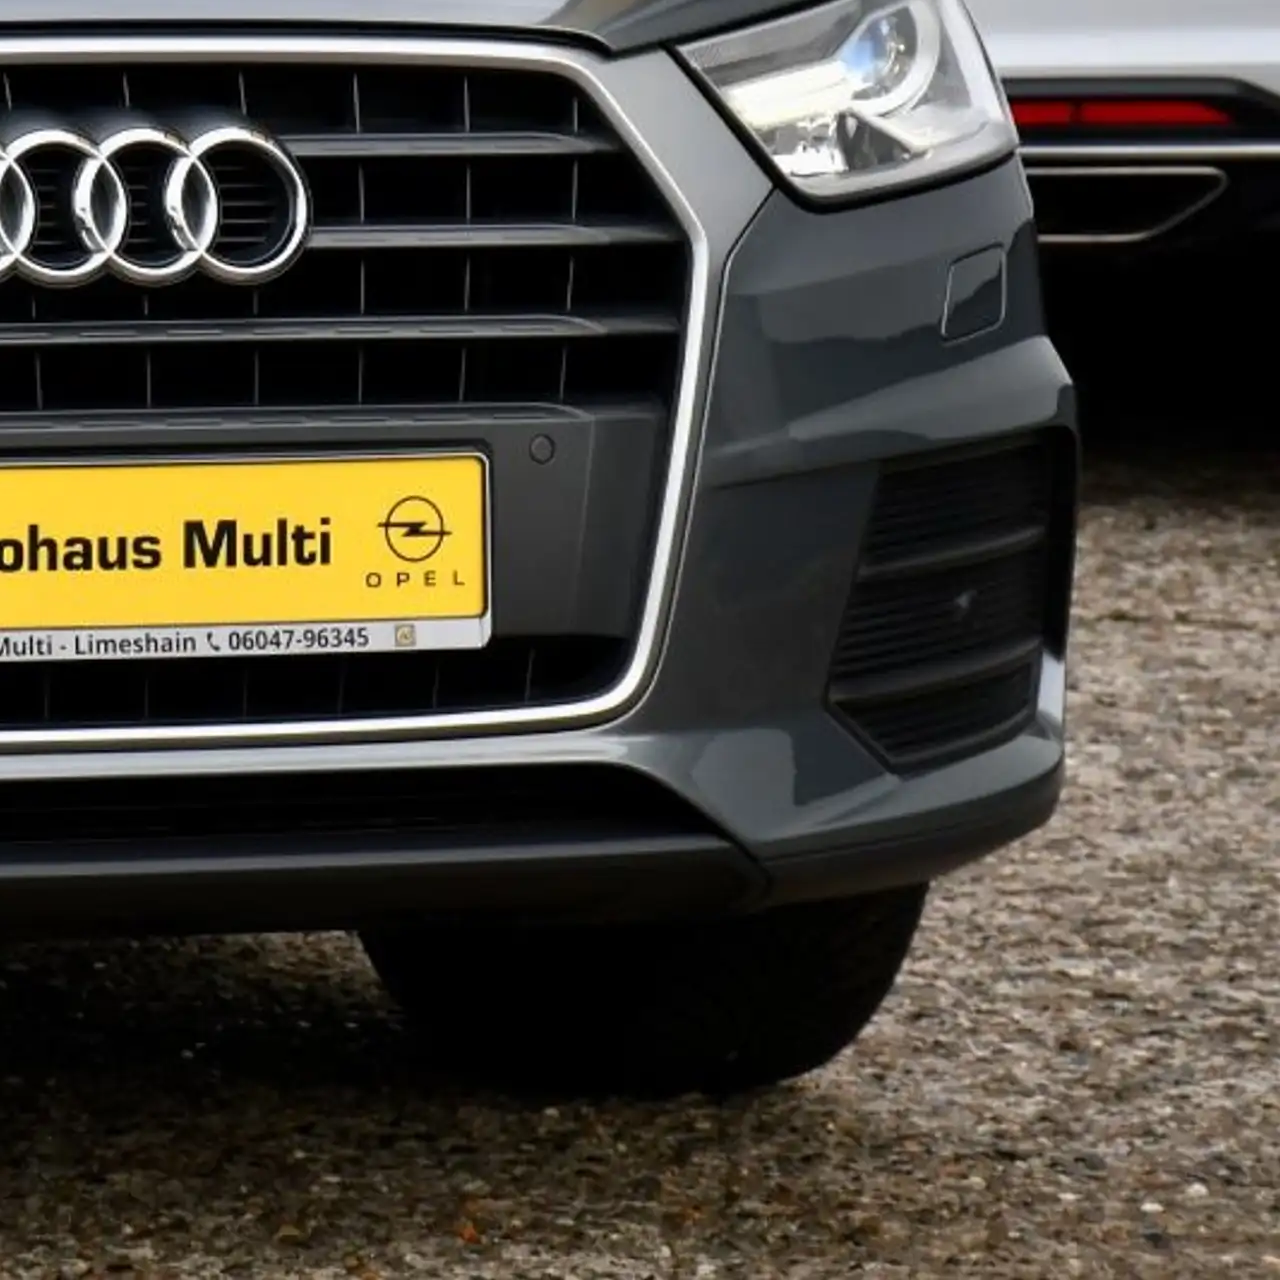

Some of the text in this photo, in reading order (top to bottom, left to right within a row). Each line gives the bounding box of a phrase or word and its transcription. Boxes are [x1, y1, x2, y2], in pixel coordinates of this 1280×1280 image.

[182, 516, 331, 569] Multi
[365, 569, 466, 588] OPEL
[74, 632, 197, 656] Limeshain
[228, 627, 370, 652] 06047-96345
